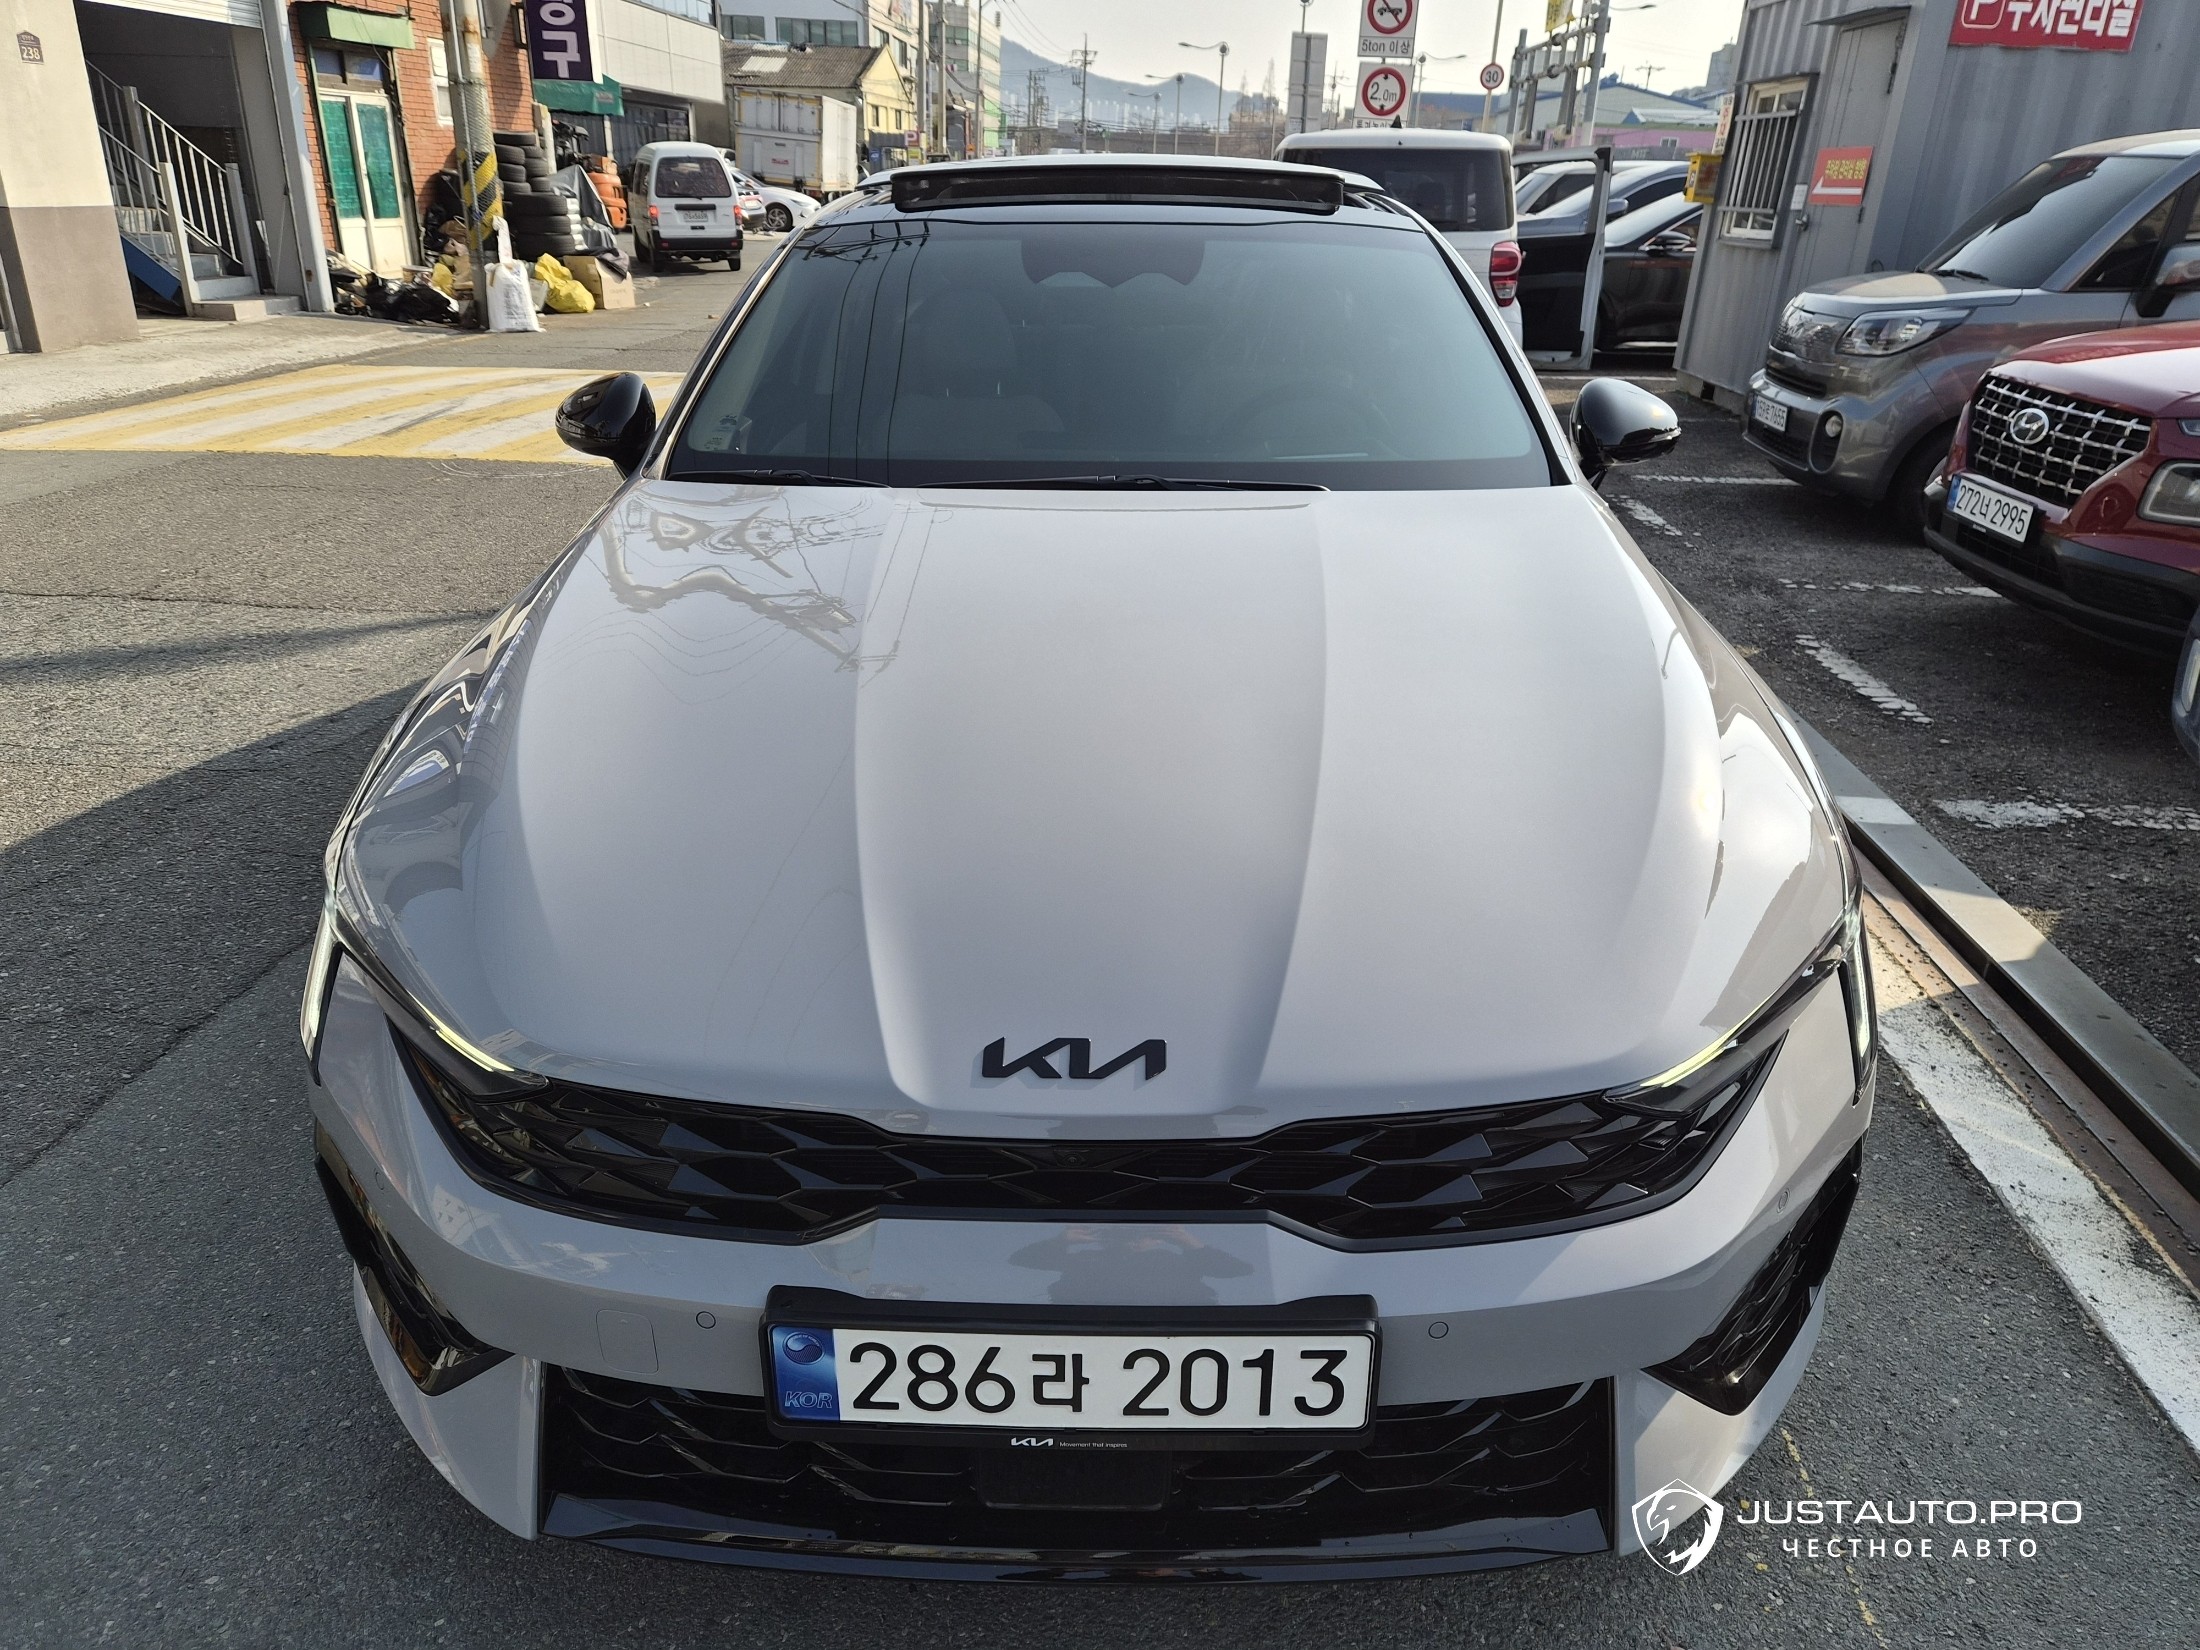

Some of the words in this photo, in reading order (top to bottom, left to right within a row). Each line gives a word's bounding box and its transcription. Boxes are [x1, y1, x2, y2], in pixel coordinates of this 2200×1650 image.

[21, 46, 41, 60] 238
[1362, 39, 1386, 52] 5ton
[1389, 40, 1411, 54] 이상
[1485, 70, 1499, 83] 30
[1370, 81, 1397, 102] 2.0m
[1956, 484, 1992, 520] 272너
[1989, 499, 2028, 535] 2995
[849, 1342, 1090, 1413] 286라
[1121, 1347, 1349, 1417] 2013
[784, 1391, 833, 1409] KOR
